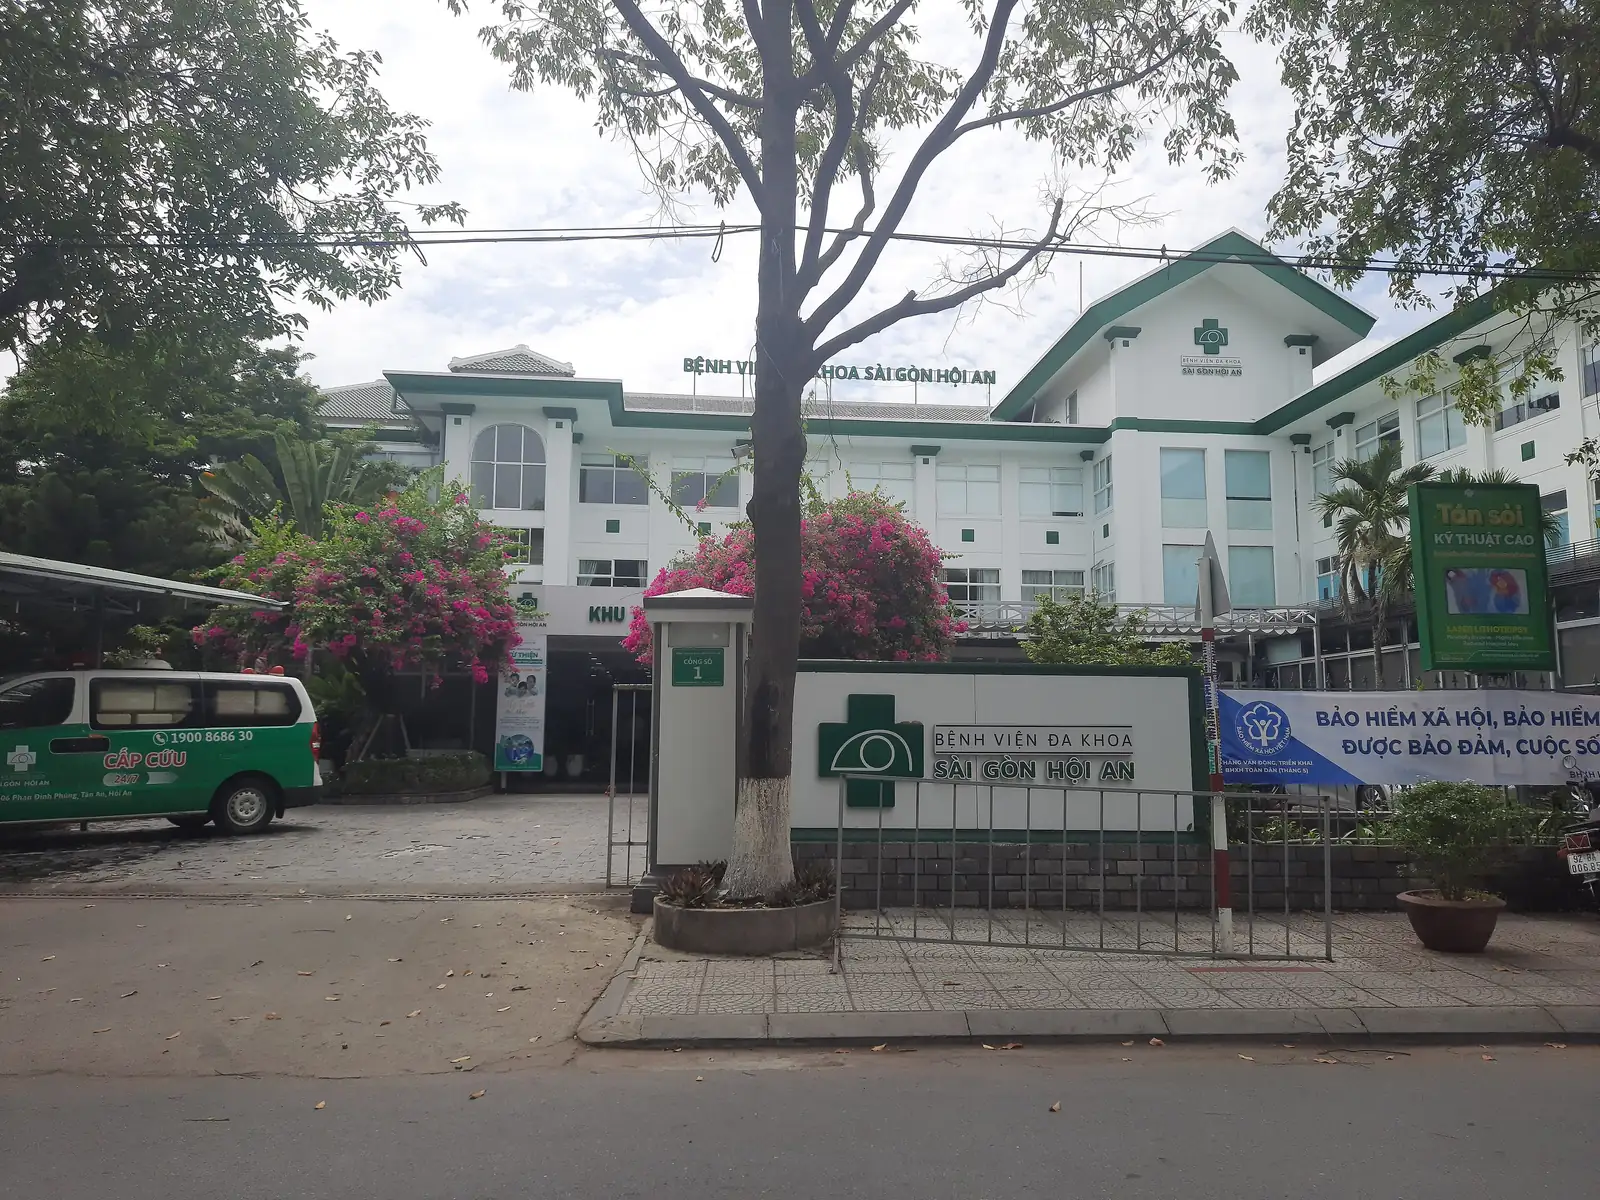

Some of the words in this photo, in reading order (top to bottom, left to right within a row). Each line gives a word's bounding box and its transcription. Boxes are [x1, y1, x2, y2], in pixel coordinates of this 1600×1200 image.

[683, 356, 732, 376] BỆNH
[736, 360, 757, 376] VI
[815, 364, 860, 381] HOA
[864, 363, 892, 381] SÀI
[895, 364, 933, 383] GÒN
[936, 366, 968, 388] HỘI
[971, 370, 996, 385] AN
[1231, 368, 1243, 376] AN
[1436, 503, 1483, 527] Tán
[1434, 531, 1453, 545] KỸ
[1455, 532, 1501, 548] THUẬT
[1503, 534, 1534, 546] CAO
[588, 605, 626, 624] KHU
[693, 666, 702, 679] 1
[1316, 705, 1360, 727] BẢO
[1365, 705, 1417, 727] HIỂM
[1421, 706, 1451, 727] XÃ
[1456, 706, 1498, 730] HỘI,
[1503, 705, 1545, 727] BẢO
[1551, 705, 1600, 727] HIỂM
[171, 732, 202, 744] 1900
[205, 731, 235, 742] 8686
[238, 731, 254, 741] 30
[935, 731, 985, 748] BỆNH
[994, 731, 1037, 749] VIỆN
[1047, 733, 1072, 747] ĐA
[1081, 733, 1132, 747] KHOA
[1342, 736, 1402, 759] ĐƯỢC
[1408, 733, 1452, 756] BẢO
[1457, 733, 1511, 758] ĐẢM,
[1516, 735, 1571, 759] CUỘC
[103, 747, 142, 769] CẤP
[145, 749, 187, 768] CỨU
[934, 755, 972, 780] SÀI
[982, 755, 1036, 779] GÒN
[1047, 757, 1091, 784] HỘI
[1101, 761, 1135, 780] AN
[114, 774, 139, 784] 24/7
[1573, 854, 1583, 863] 92
